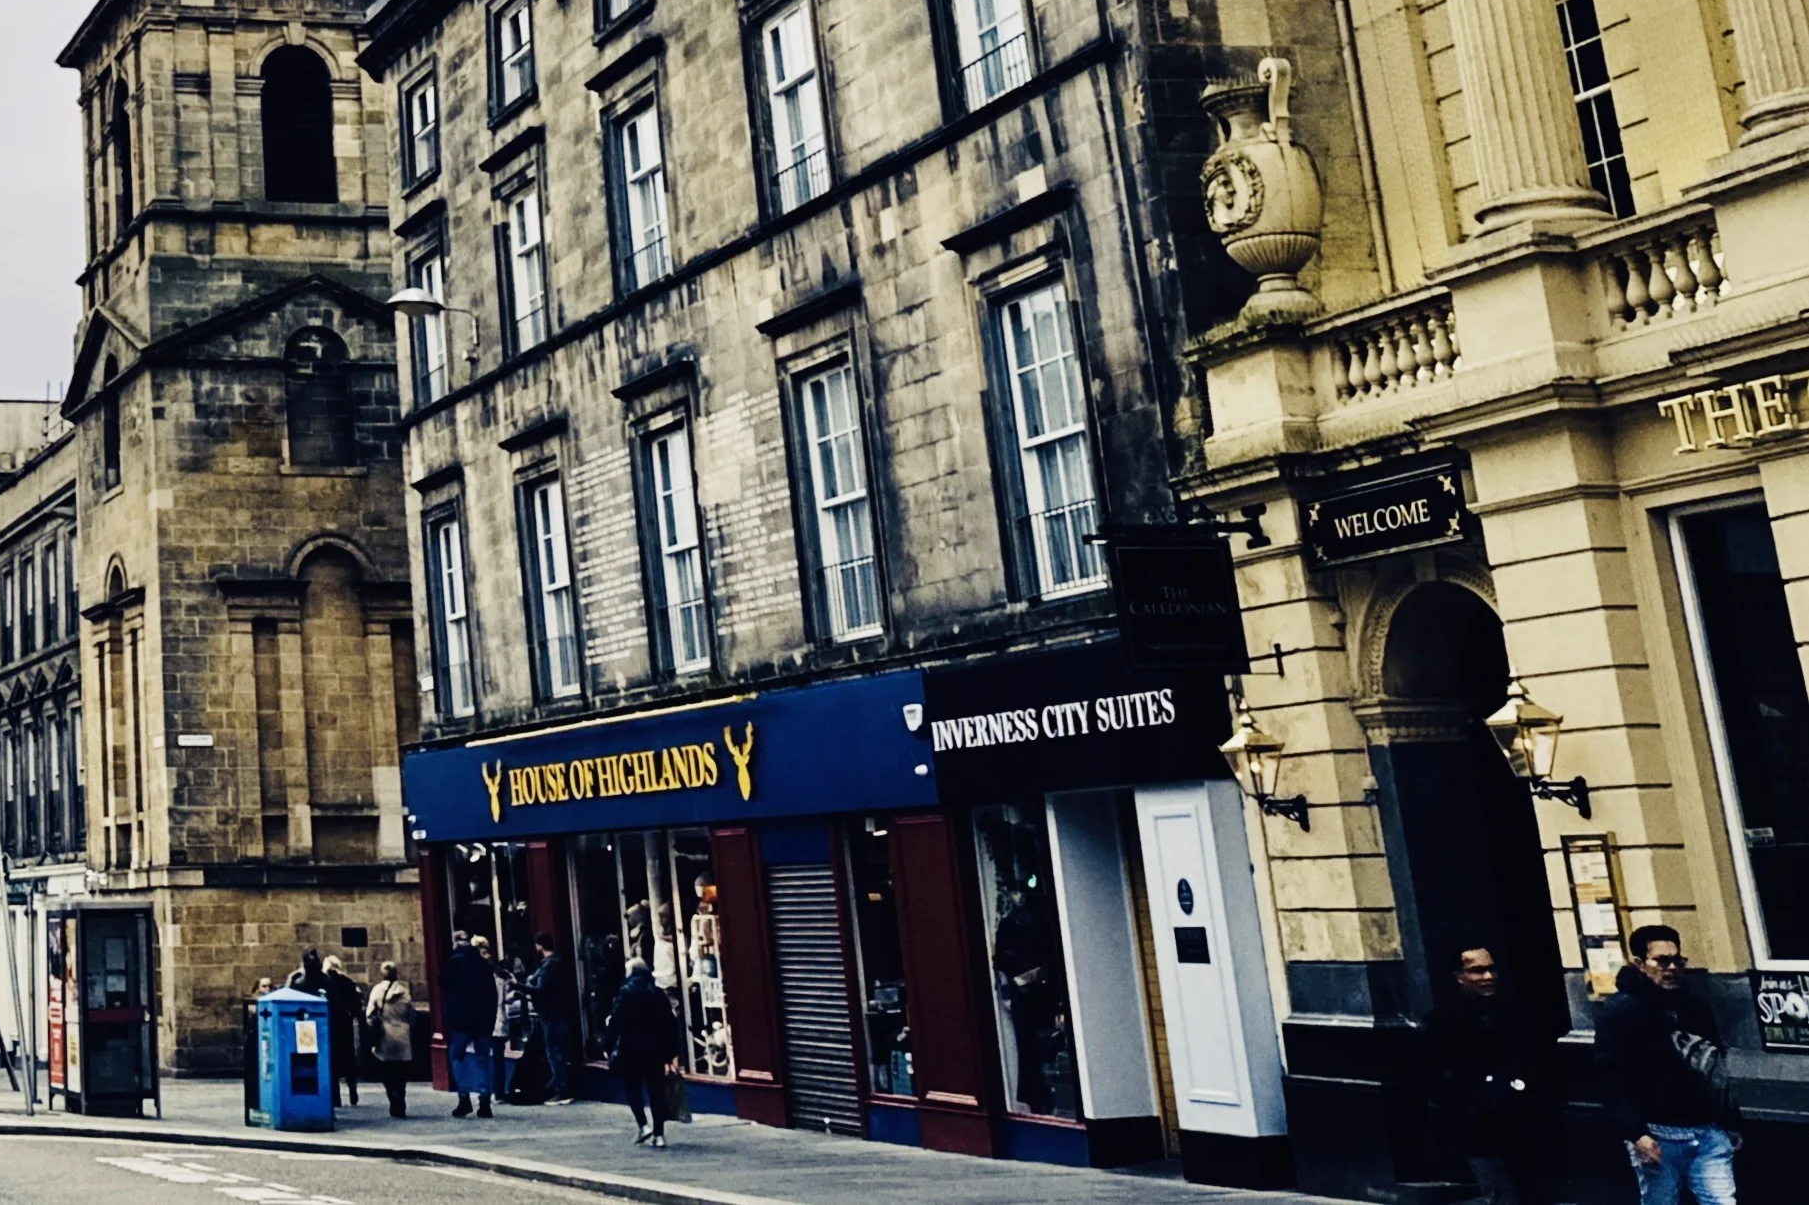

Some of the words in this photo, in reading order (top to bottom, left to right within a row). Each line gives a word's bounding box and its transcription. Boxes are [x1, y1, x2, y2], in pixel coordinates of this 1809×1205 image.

[1658, 374, 1793, 455] THE
[1334, 499, 1431, 539] WELCOME
[1128, 602, 1228, 615] CALEDONIAN
[1160, 586, 1189, 600] THE
[931, 708, 1040, 751] INVERNESS
[1042, 701, 1090, 738] CITY
[1095, 688, 1176, 732] SUITES
[509, 762, 570, 806] HOUSE
[569, 759, 595, 799] OF
[593, 742, 719, 797] HIGHLANDS
